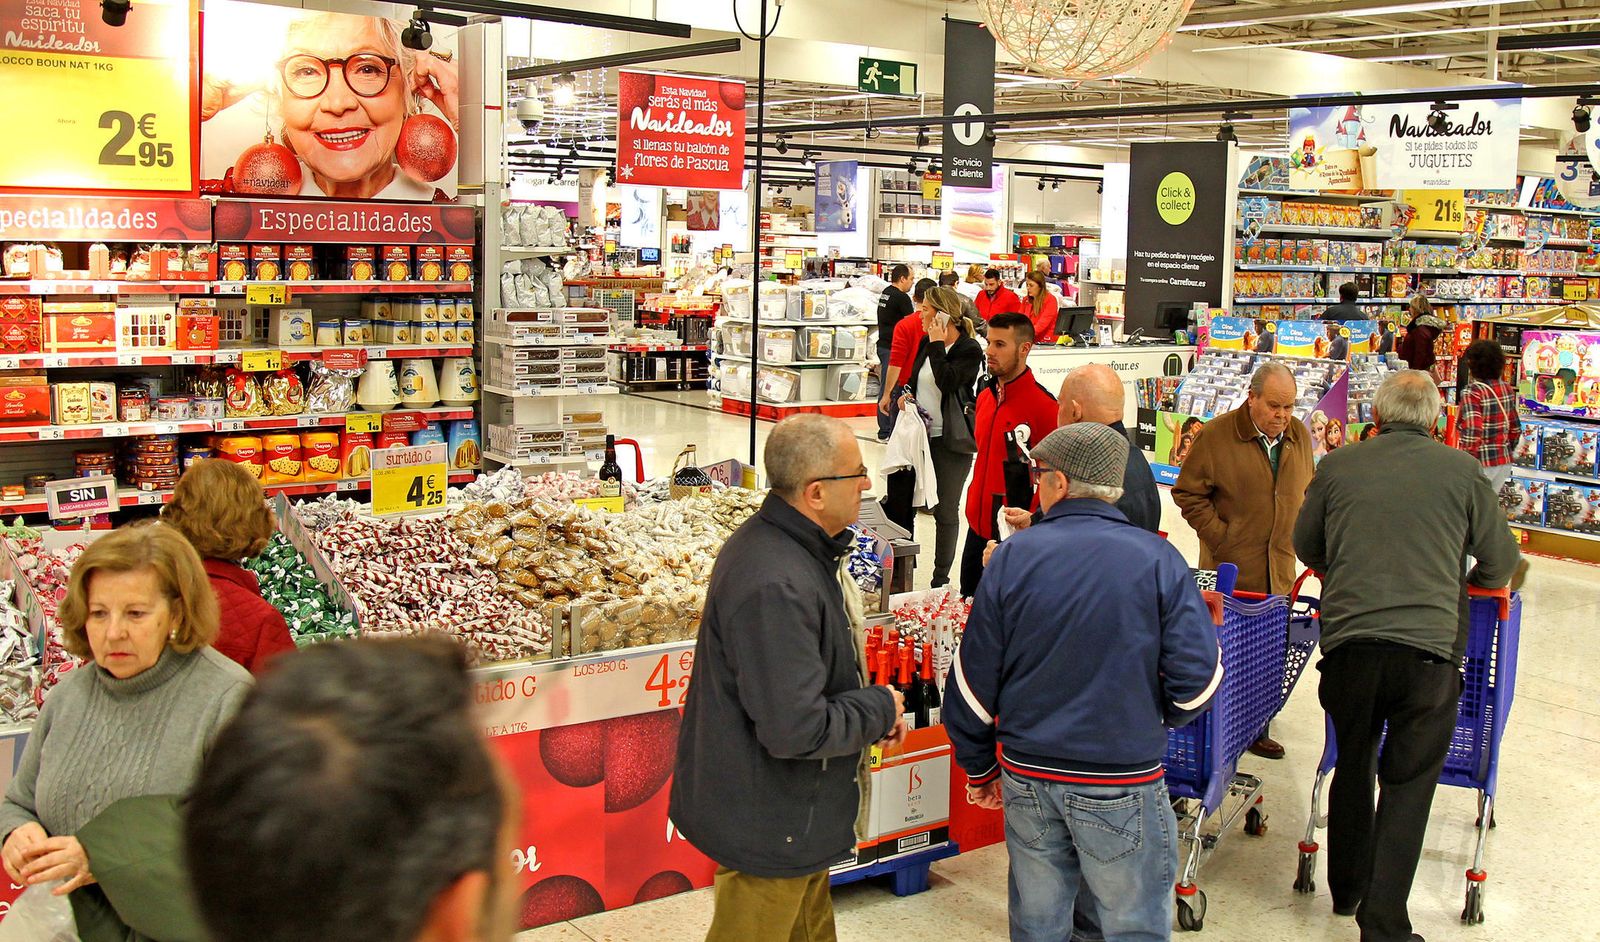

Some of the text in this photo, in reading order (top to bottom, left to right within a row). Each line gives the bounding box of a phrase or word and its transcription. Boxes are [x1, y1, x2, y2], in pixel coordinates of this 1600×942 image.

[25, 4, 80, 20] saca tu
[21, 17, 85, 34] espíritu
[5, 30, 101, 53] Navideador
[0, 56, 114, 71] OCCO BOUN NAT 1KG
[661, 86, 707, 98] Esta Navidad
[648, 95, 718, 112] serás el más
[630, 106, 734, 137] Navideador
[1389, 112, 1493, 138] Navieador
[98, 110, 136, 166] 2
[1405, 139, 1478, 153] Si te pides todos los
[633, 138, 730, 155] si llenas tu balcón de
[634, 152, 730, 171] flores de Pascua
[952, 156, 983, 168] Servicio
[1409, 153, 1473, 169] JUGUETES
[951, 168, 983, 178] al cliente
[243, 177, 291, 190] #navidear
[1160, 187, 1191, 198] Click &
[1160, 200, 1191, 211] collect
[1434, 199, 1451, 222] 21
[259, 208, 432, 234] Especialidades
[1191, 254, 1215, 262] recógelo
[1160, 262, 1180, 270] espacio
[1181, 263, 1199, 271] cliente
[1169, 277, 1206, 287] Carrefour.es
[386, 451, 423, 466] surtido
[70, 488, 96, 502] SIN
[406, 475, 425, 507] 4
[574, 662, 595, 677] LOS
[597, 660, 615, 675] 250
[644, 653, 677, 708] 4
[679, 674, 691, 706] 2
[475, 678, 516, 706] tido
[500, 724, 509, 735] A
